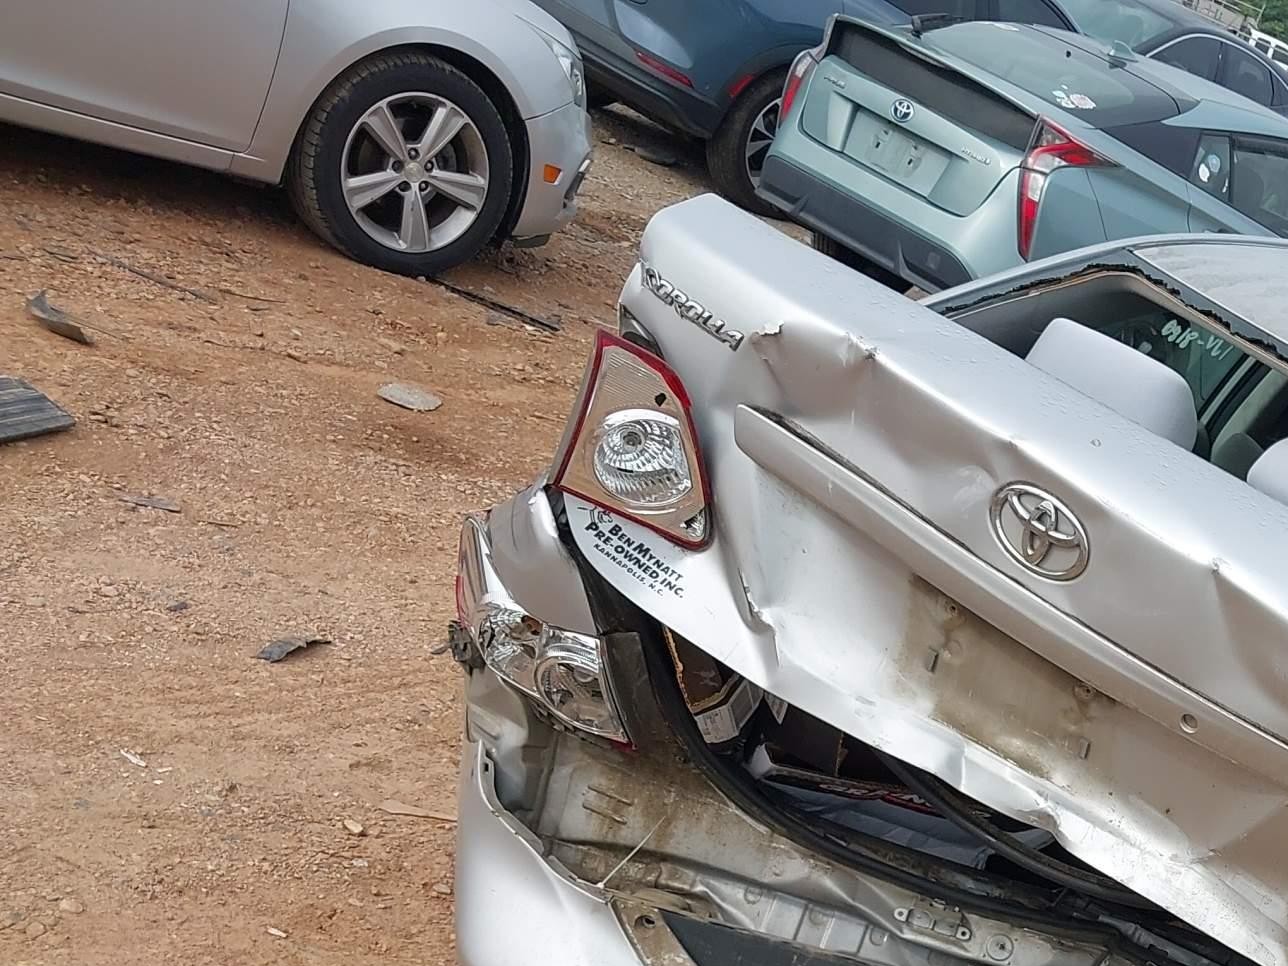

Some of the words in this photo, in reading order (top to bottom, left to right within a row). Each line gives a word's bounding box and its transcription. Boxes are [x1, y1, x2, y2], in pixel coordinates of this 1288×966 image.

[608, 523, 636, 548] BEN
[632, 542, 684, 582] MYNATT
[659, 577, 685, 599] INC.
